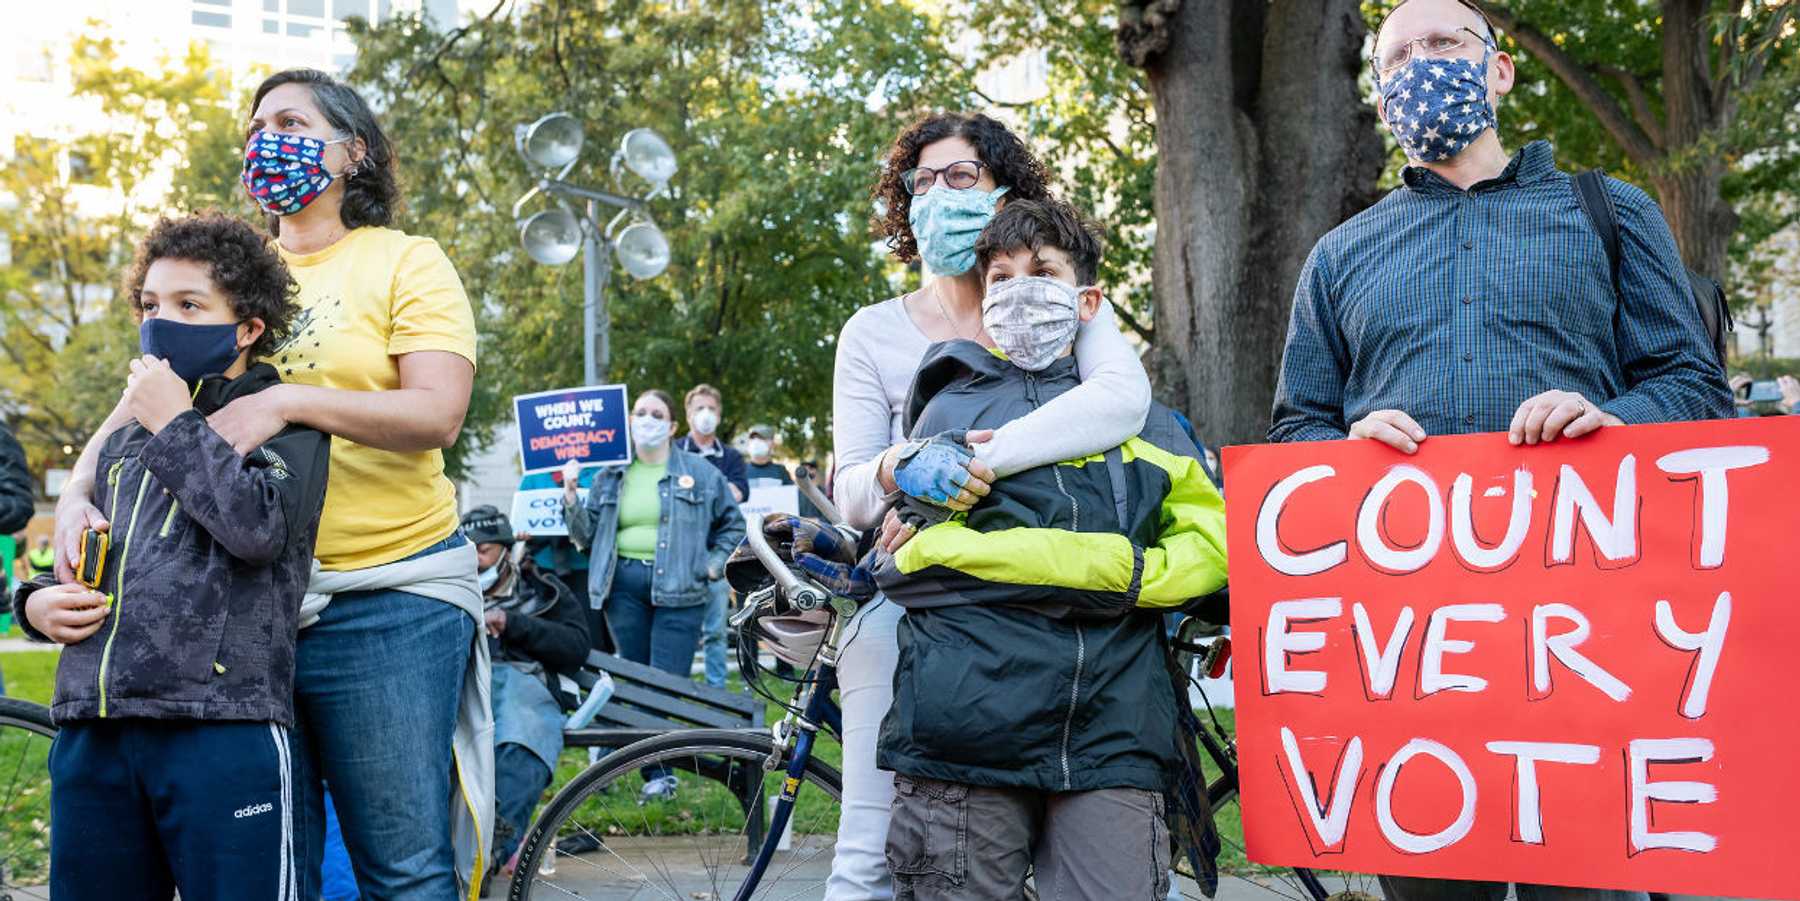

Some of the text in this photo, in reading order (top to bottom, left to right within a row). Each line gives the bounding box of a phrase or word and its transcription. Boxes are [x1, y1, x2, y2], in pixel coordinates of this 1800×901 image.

[535, 398, 604, 418] WHEN WE
[543, 413, 596, 430] COUNT,
[530, 429, 615, 451] DEMOCRACY
[554, 445, 590, 460] WINS
[1256, 446, 1770, 576] COUNT
[1259, 591, 1732, 719] EVERY
[1276, 726, 1719, 857] VOTE
[234, 802, 273, 818] adidas
